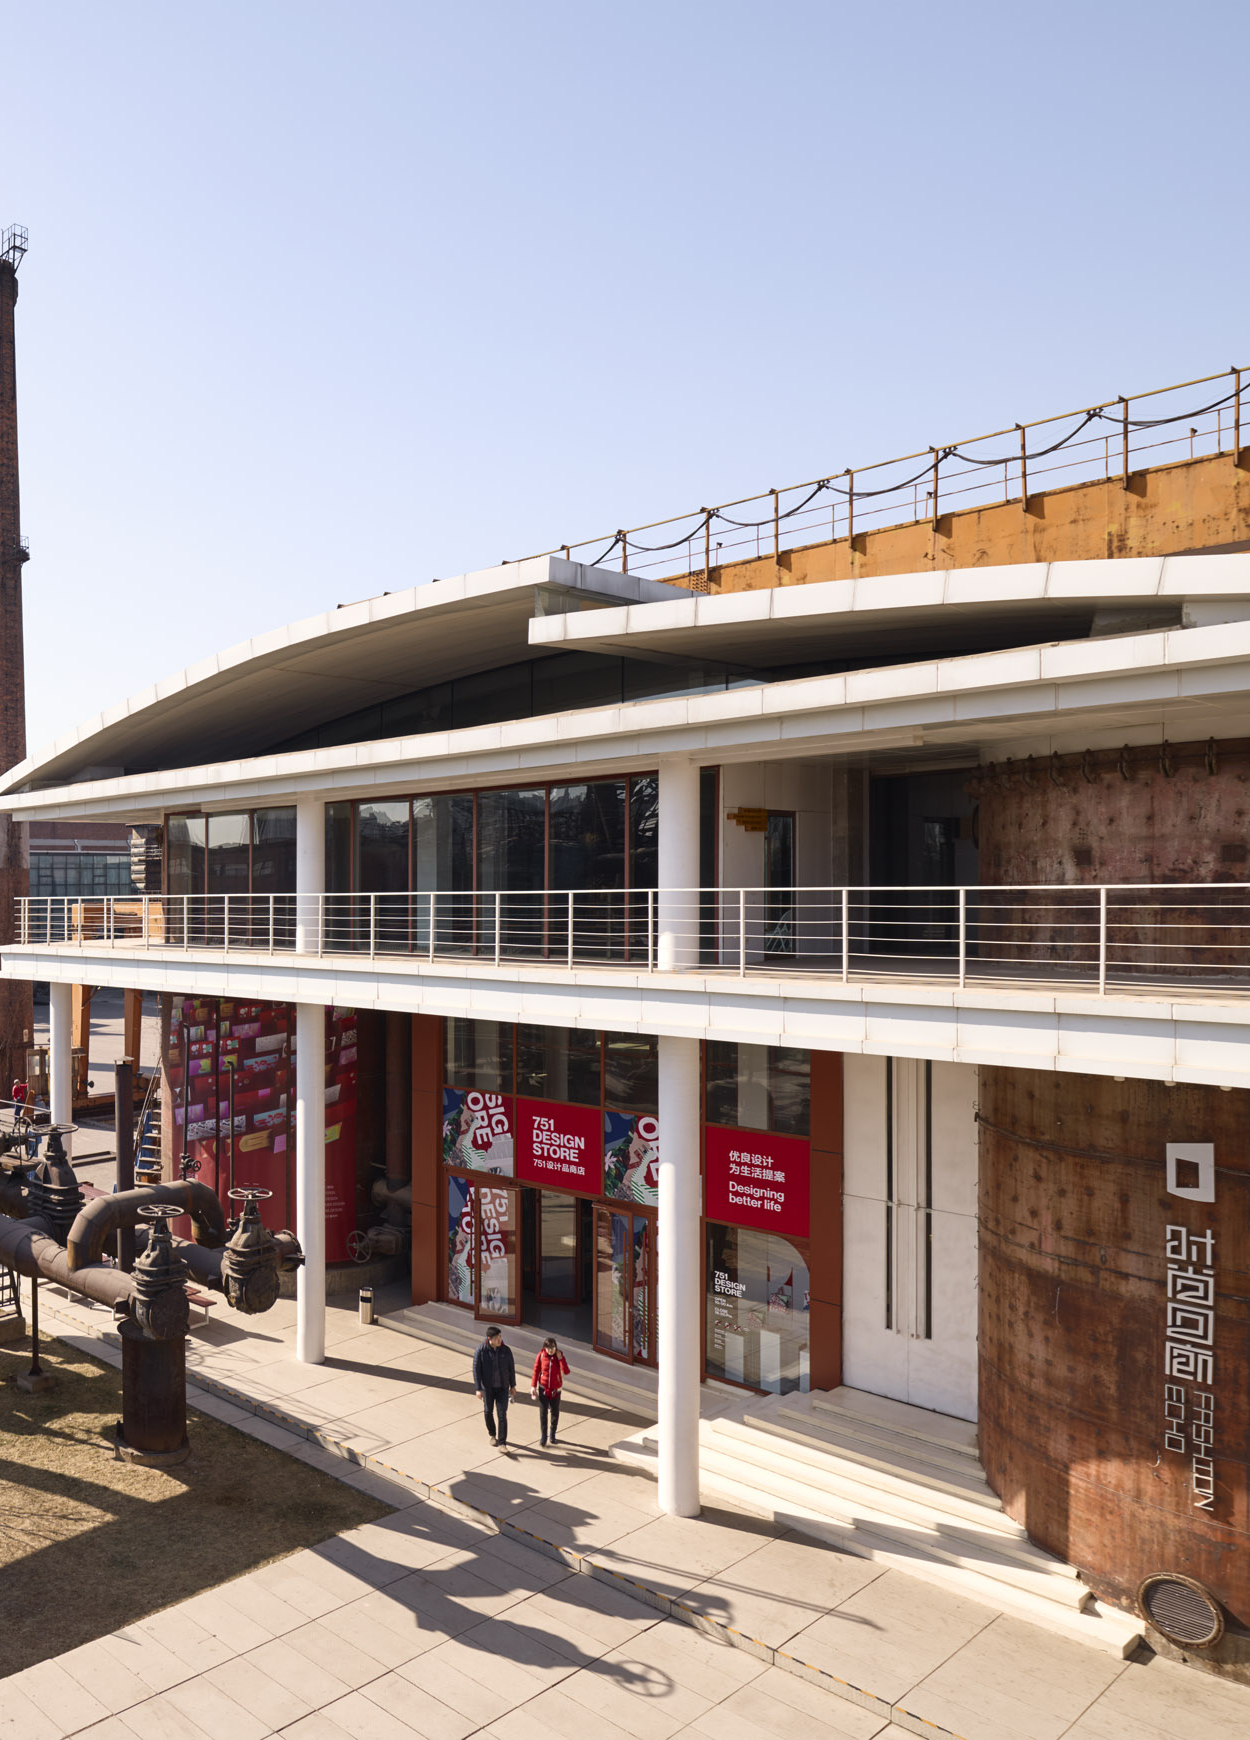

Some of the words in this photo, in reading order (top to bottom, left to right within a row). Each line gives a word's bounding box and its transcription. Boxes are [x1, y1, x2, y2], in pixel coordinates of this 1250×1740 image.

[532, 1115, 554, 1131] 751
[532, 1129, 585, 1150] DESIGN
[532, 1142, 579, 1162] STORE
[729, 1150, 774, 1168] 优良设计
[533, 1158, 586, 1176] 751设计品商店
[729, 1163, 786, 1183] 为生活提案
[729, 1181, 785, 1203] Designing
[729, 1192, 762, 1208] better
[764, 1199, 782, 1212] life
[714, 1270, 728, 1280] 751
[714, 1278, 746, 1291] DESIGN
[714, 1285, 743, 1298] STORE
[1165, 1384, 1185, 1454] ECHO
[1193, 1391, 1214, 1511] FASHION
